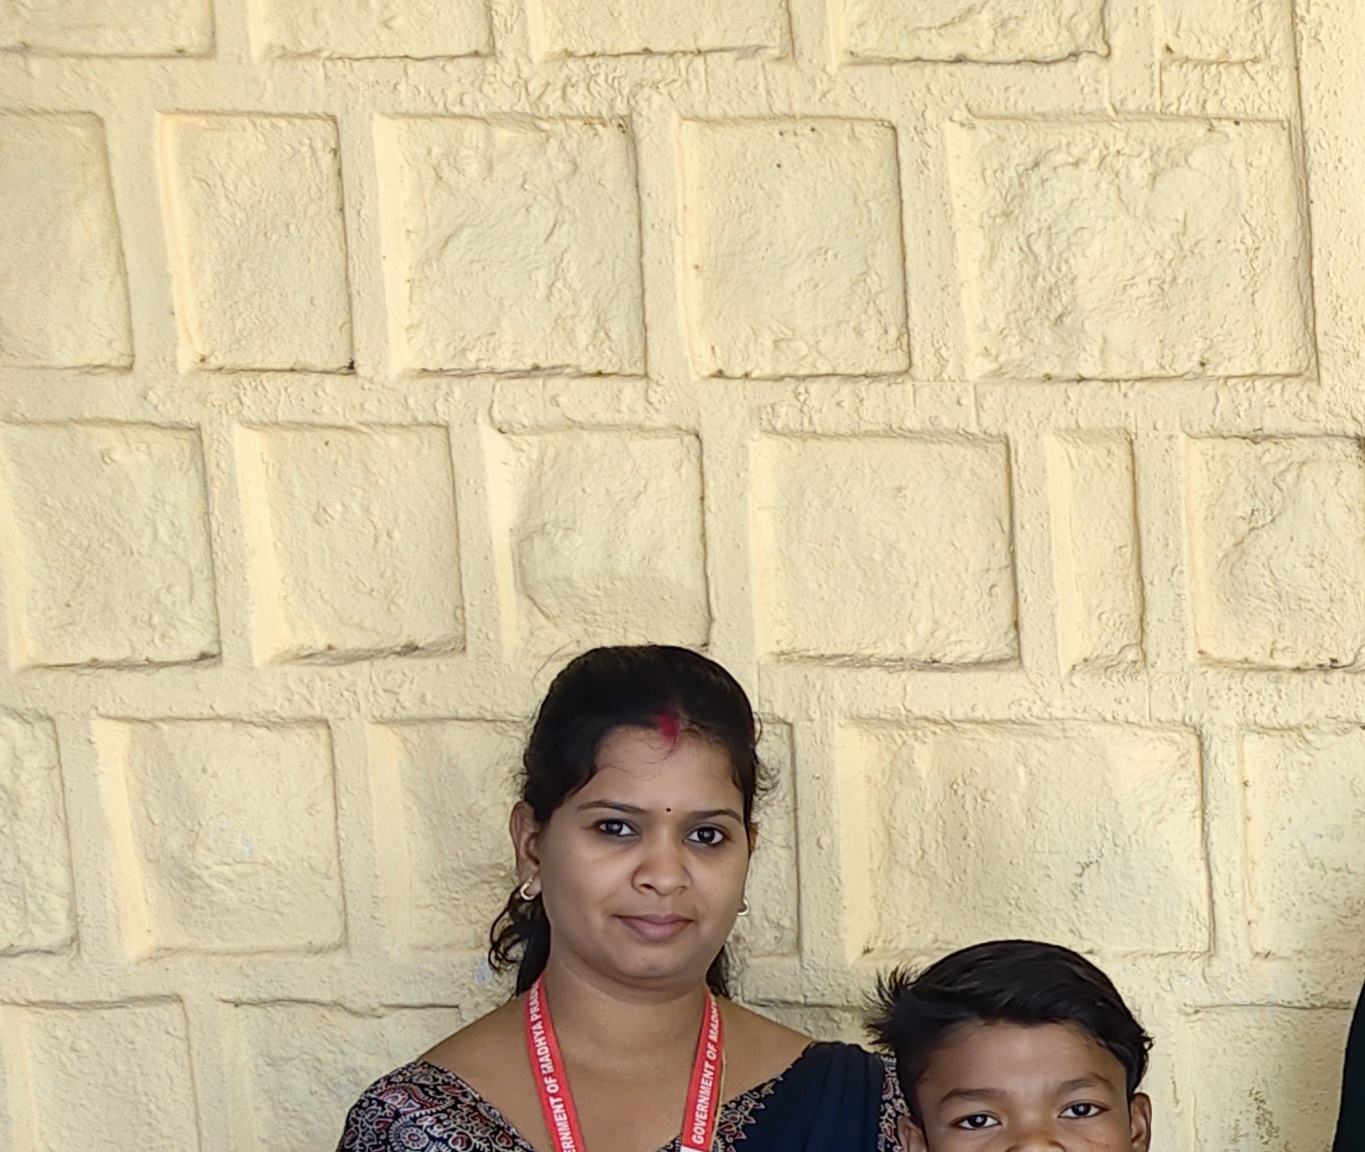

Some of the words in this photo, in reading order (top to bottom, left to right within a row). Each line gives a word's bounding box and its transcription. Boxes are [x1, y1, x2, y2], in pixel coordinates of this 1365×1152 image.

[531, 1021, 555, 1076] MADHYA
[544, 1078, 560, 1093] OF
[691, 1061, 716, 1145] GOVERNMENT
[706, 1042, 717, 1060] OF
